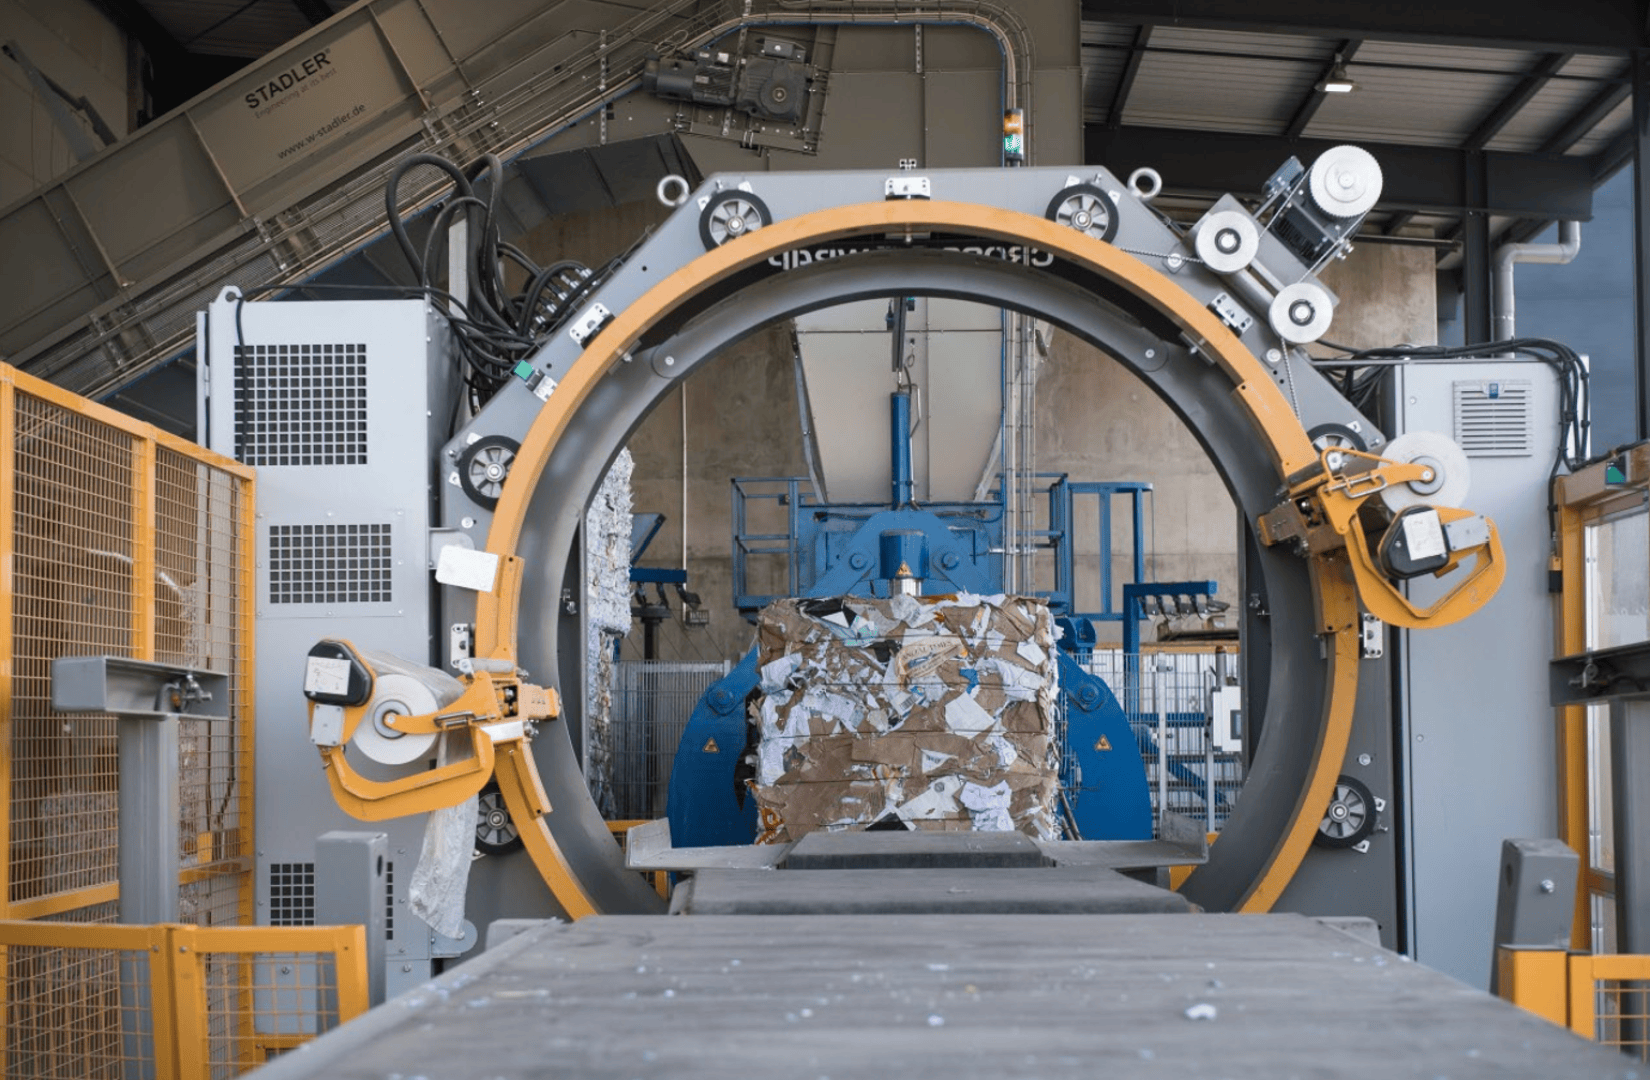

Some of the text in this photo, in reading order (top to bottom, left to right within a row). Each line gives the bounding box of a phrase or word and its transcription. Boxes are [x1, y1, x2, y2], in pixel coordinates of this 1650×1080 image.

[254, 67, 338, 119] Engineering at its best
[277, 103, 366, 160] www.w-stadler.de
